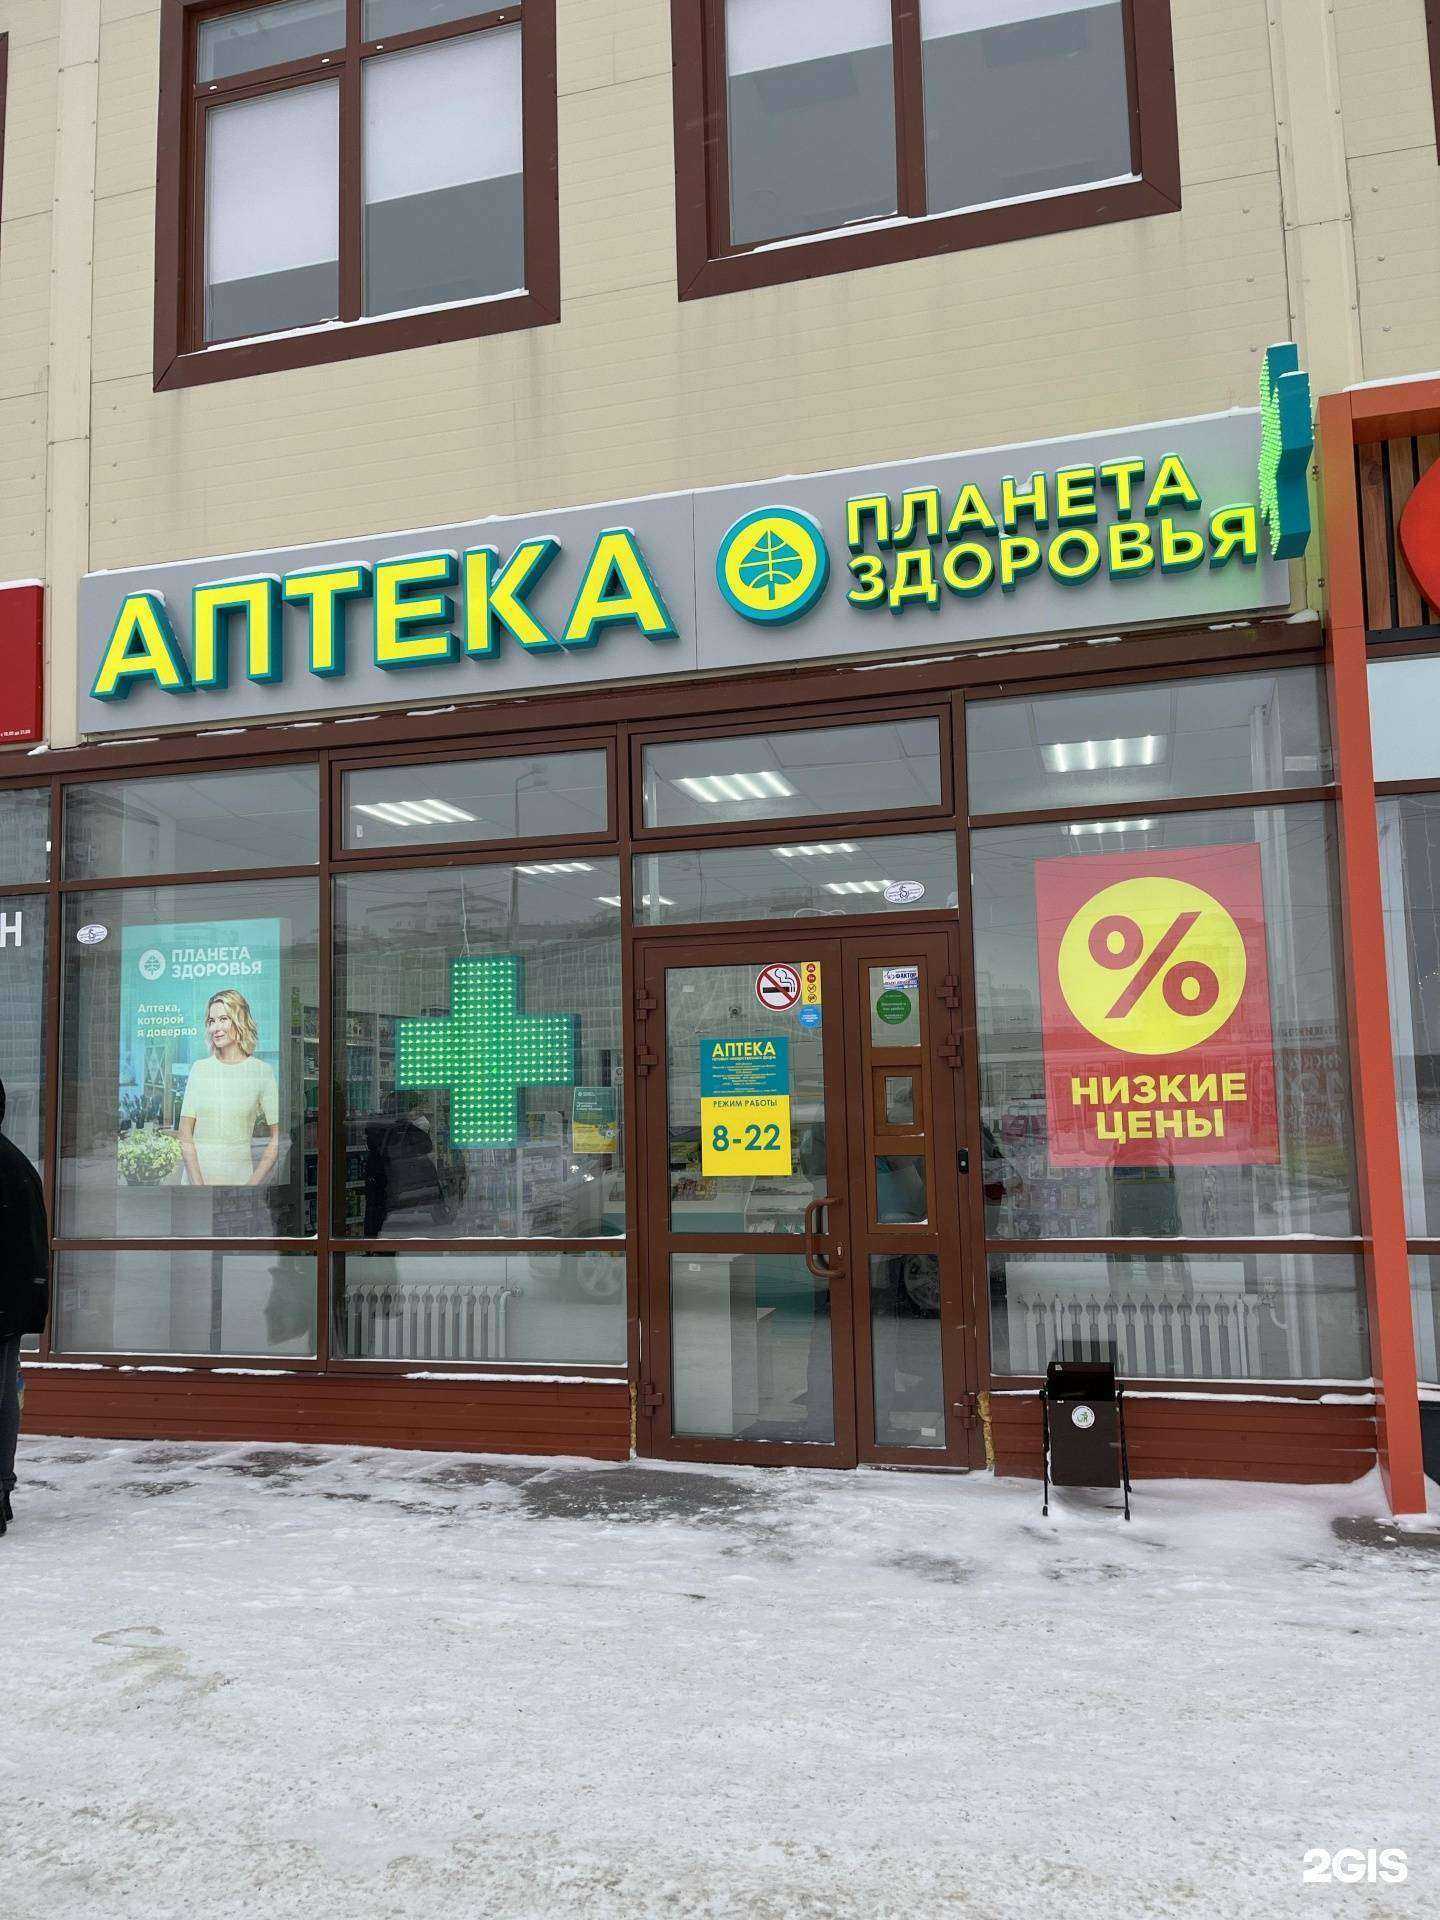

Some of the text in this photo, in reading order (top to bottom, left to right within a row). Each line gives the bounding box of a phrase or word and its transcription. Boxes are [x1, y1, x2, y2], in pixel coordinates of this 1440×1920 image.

[845, 453, 1202, 550] ПЛАНЕТА
[847, 503, 1260, 614] ЗДОРОВЬЯ
[92, 527, 679, 700] АПТЕКА
[171, 946, 252, 963] ПЛАНЕТА
[1088, 912, 1219, 1018] %
[171, 961, 263, 980] ЗДОРОВЬЯ
[137, 1003, 181, 1015] Аптека,
[137, 1015, 184, 1026] которой
[137, 1026, 198, 1038] я доверяю
[711, 1041, 777, 1057] АПТЕКА
[1071, 1072, 1248, 1106] НИЗКИЕ
[713, 1099, 778, 1108] РЕЖИМ РАБОТЫ
[712, 1123, 781, 1152] 8-22
[1096, 1109, 1224, 1145] ЦЕНЫ
